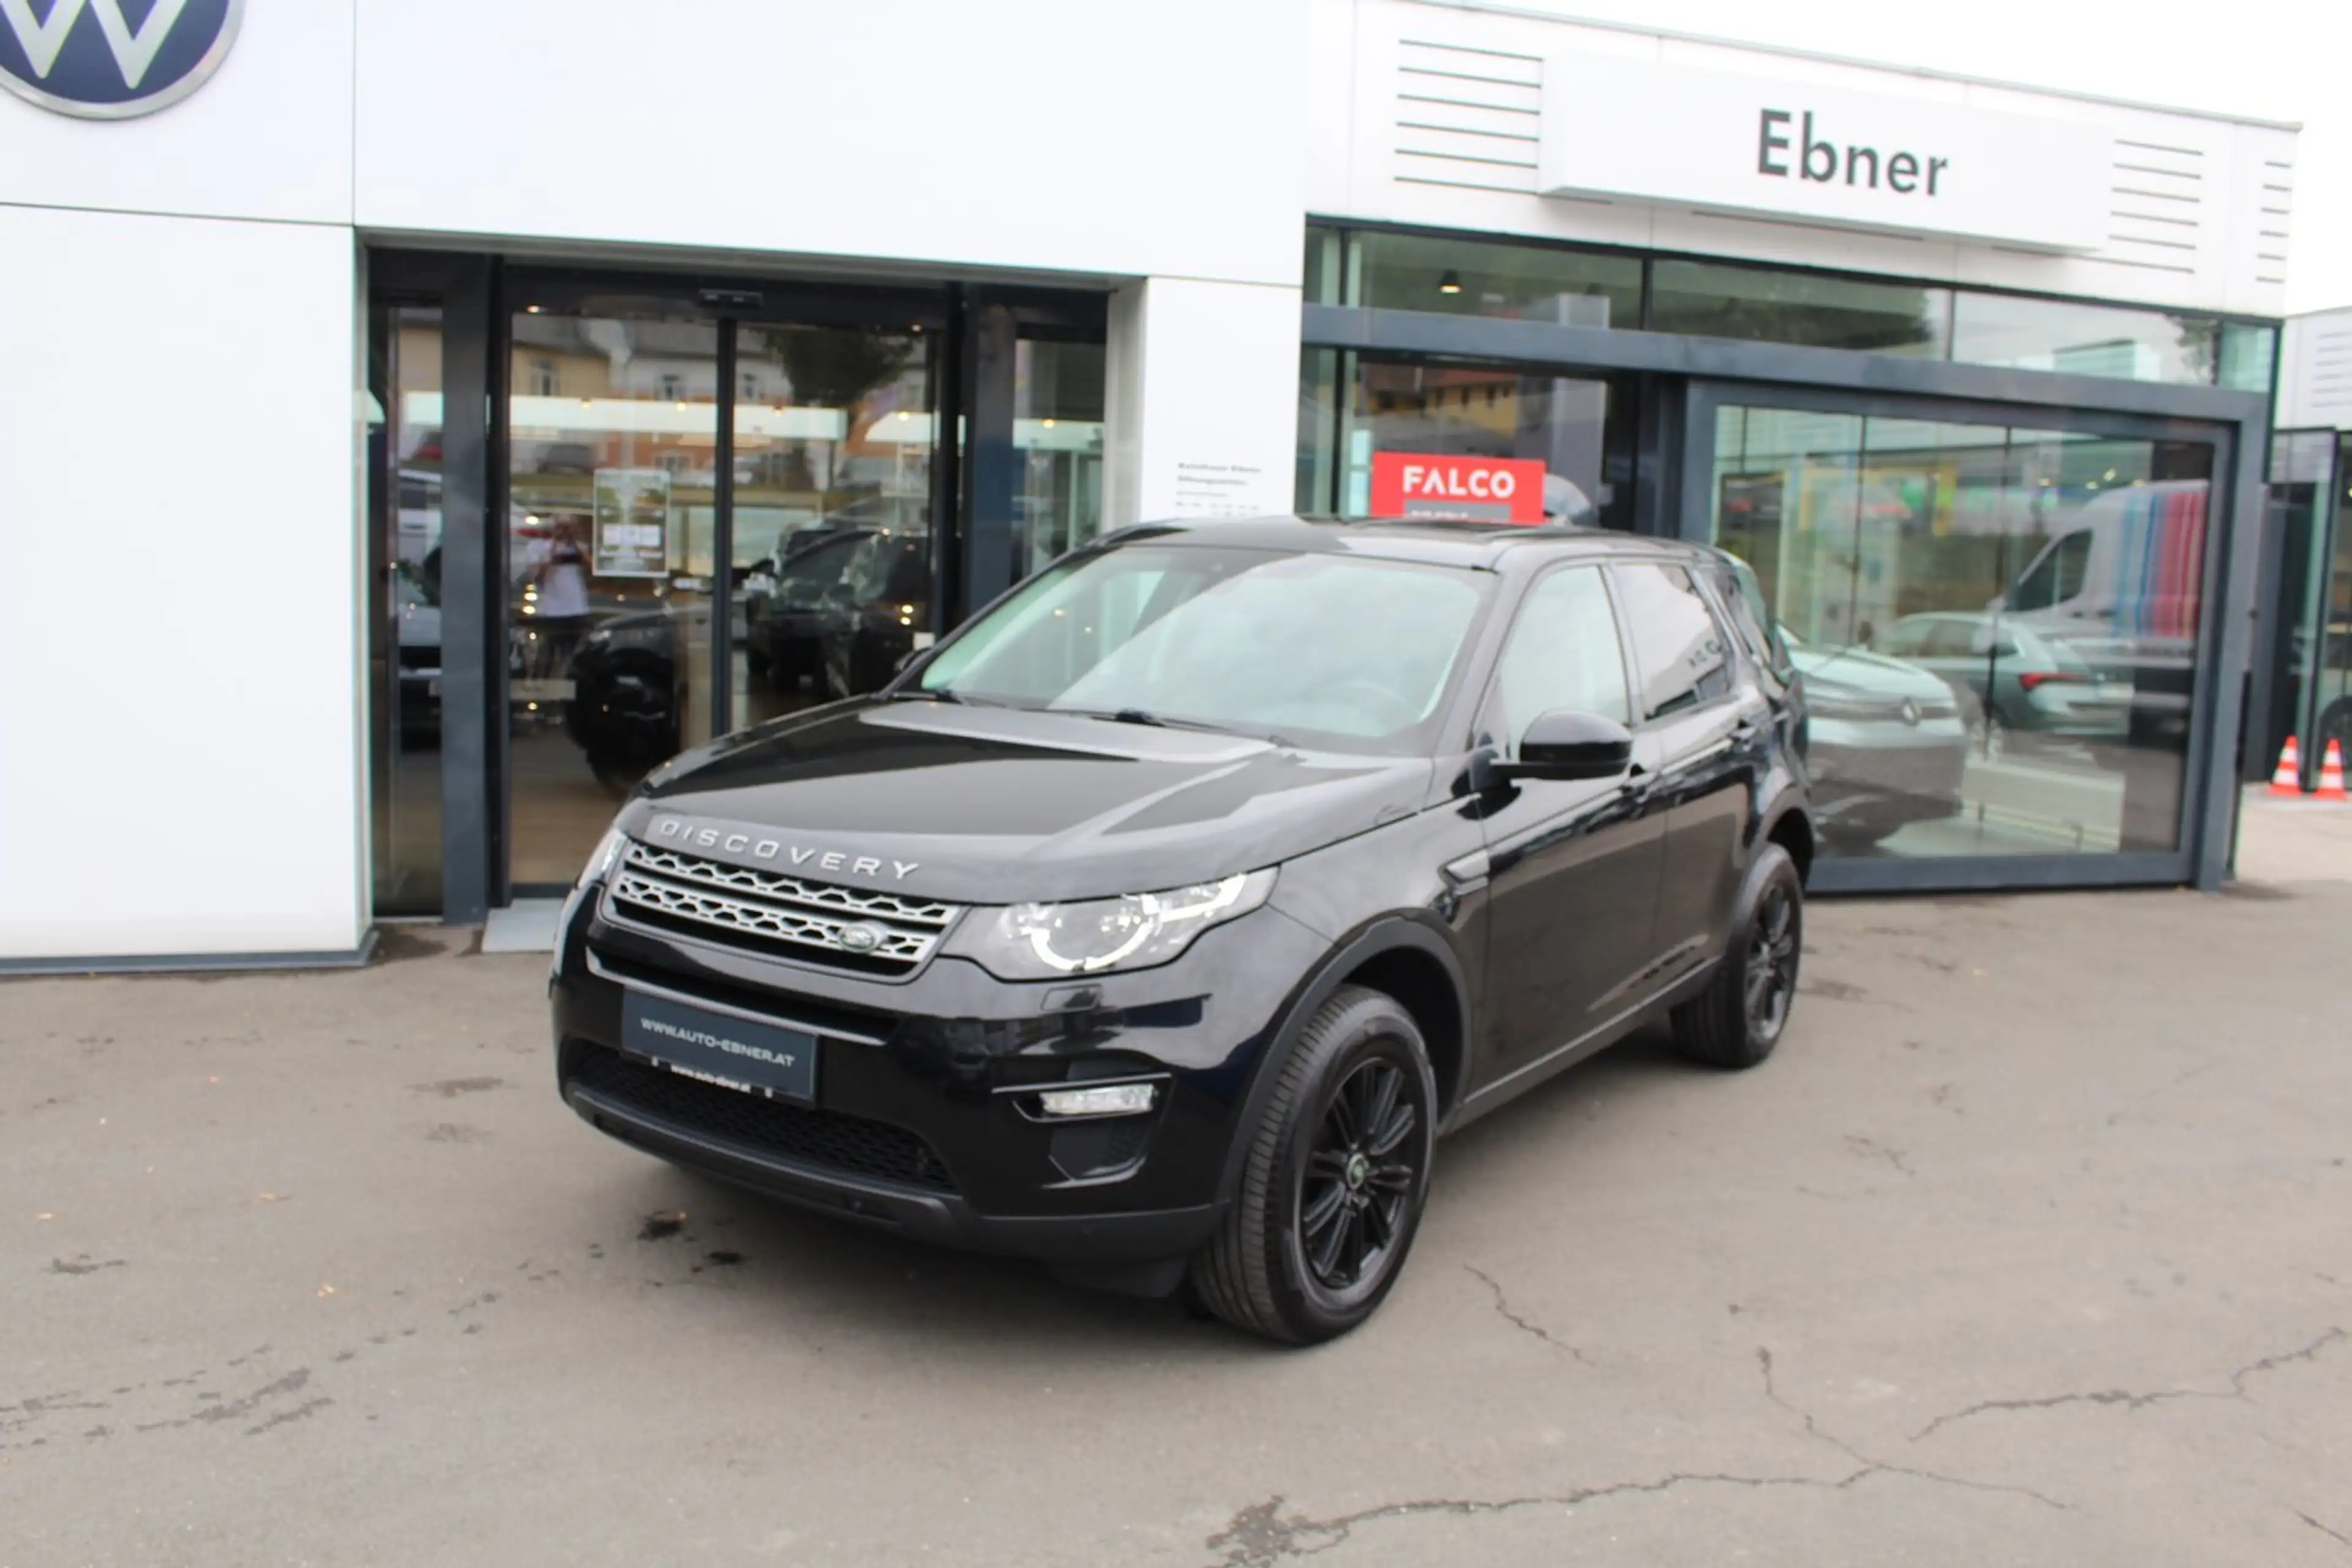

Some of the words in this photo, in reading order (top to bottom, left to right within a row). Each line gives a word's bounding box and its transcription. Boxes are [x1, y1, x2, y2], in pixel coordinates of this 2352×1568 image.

[1758, 108, 1950, 197] Ebner
[1402, 465, 1516, 499] FALCO
[660, 819, 918, 880] DISCOVERY
[640, 1017, 796, 1067] WWW.AUTO-EBNER.AT
